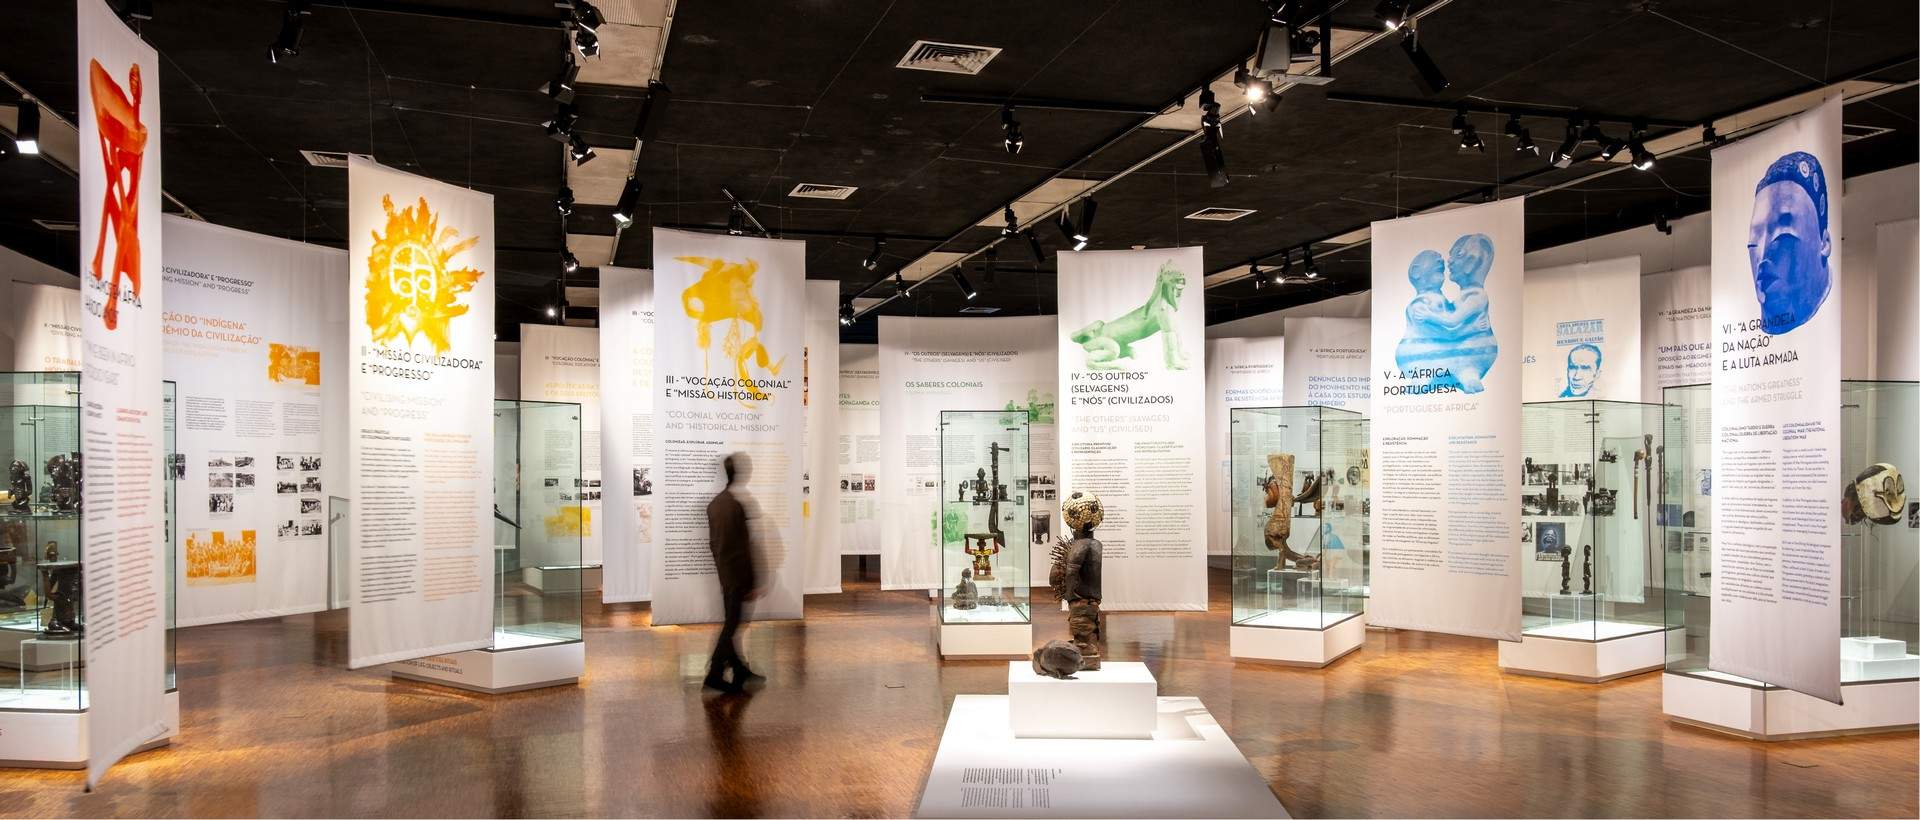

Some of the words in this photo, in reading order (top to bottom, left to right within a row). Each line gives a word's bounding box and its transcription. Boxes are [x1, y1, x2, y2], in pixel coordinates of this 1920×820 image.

[166, 266, 210, 279] CIVILIZADORA"
[215, 275, 254, 288] "PROGRESSO"
[203, 282, 216, 290] AND
[217, 284, 251, 296] "PROGRESS"
[184, 315, 197, 325] DO
[200, 316, 247, 331] "INDÍGENA"
[1723, 324, 1732, 335] VI
[1738, 321, 1747, 333] "A
[1749, 312, 1795, 332] GRANDEZA
[191, 328, 203, 338] DA
[206, 329, 263, 346] CIVILIZAÇÃO"
[1723, 342, 1735, 353] DA
[1737, 334, 1773, 352] NAÇÃO"
[1689, 343, 1704, 351] QUE
[373, 348, 412, 363] "MISSÃO
[414, 353, 483, 371] CIVILIZADORA"
[1723, 359, 1728, 371] E
[1731, 360, 1737, 370] A
[1739, 355, 1761, 369] LUTA
[1763, 350, 1799, 366] ARMADA
[361, 363, 367, 374] E
[368, 364, 435, 381] "PROGRESSO"
[1071, 373, 1080, 381] IV
[1086, 373, 1103, 381] "OS
[1105, 372, 1148, 381] OUTROS"
[1383, 371, 1391, 380] V
[1399, 371, 1406, 380] A
[1408, 367, 1452, 380] "ÁFRICA
[666, 375, 674, 384] III
[681, 376, 736, 389] "VOCAÇÃO
[738, 379, 791, 389] COLONIAL"
[905, 381, 915, 389] OS
[916, 381, 944, 389] SABERES
[946, 381, 983, 389] COLONIAIS
[1071, 384, 1129, 393] (SELVAGENS)
[1383, 382, 1461, 396] PORTUGUESA"
[666, 389, 671, 398] E
[674, 388, 715, 399] "MISSÃO
[717, 390, 772, 401] HISTÓRICA"
[1071, 396, 1077, 405] E
[1078, 395, 1106, 405] "NÓS"
[1108, 395, 1174, 405] (CIVILIZADOS)
[1750, 394, 1772, 404] ARMED
[1773, 390, 1803, 402] STRUGGLE
[1384, 404, 1443, 414] "PORTUGUESE
[1445, 402, 1479, 412] AFRICA"
[665, 410, 712, 420] "COLONIAL
[716, 411, 763, 422] VOCATION"
[665, 422, 684, 431] AND
[686, 422, 739, 432] "HISTORICAL
[741, 424, 779, 433] MISSION"
